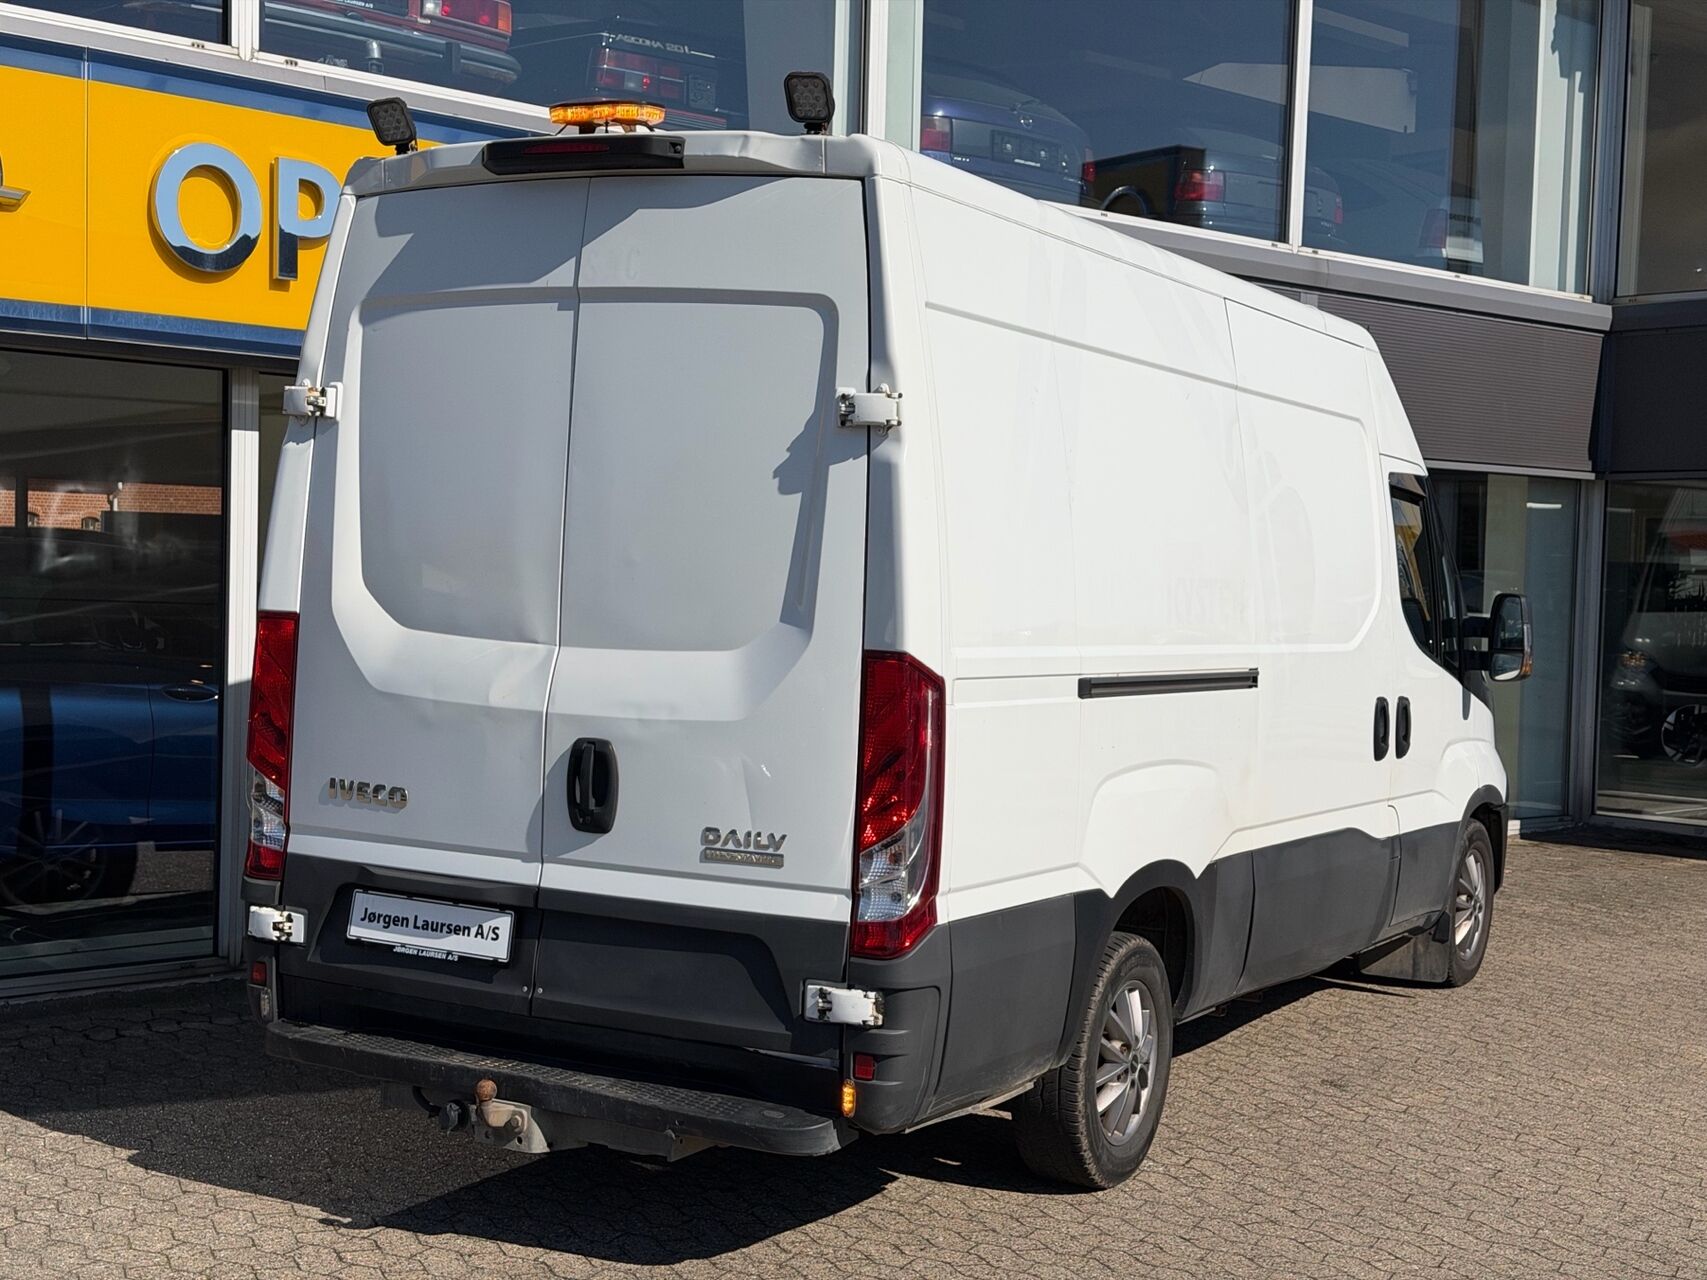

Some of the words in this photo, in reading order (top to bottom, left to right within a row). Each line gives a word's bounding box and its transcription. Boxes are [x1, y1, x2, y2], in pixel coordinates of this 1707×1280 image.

[329, 777, 408, 810] IVECO
[701, 826, 787, 853] DAILY
[360, 907, 409, 929] Jørgen
[413, 915, 472, 938] Laursen
[474, 923, 500, 942] A/S
[418, 949, 447, 960] LAURSEN
